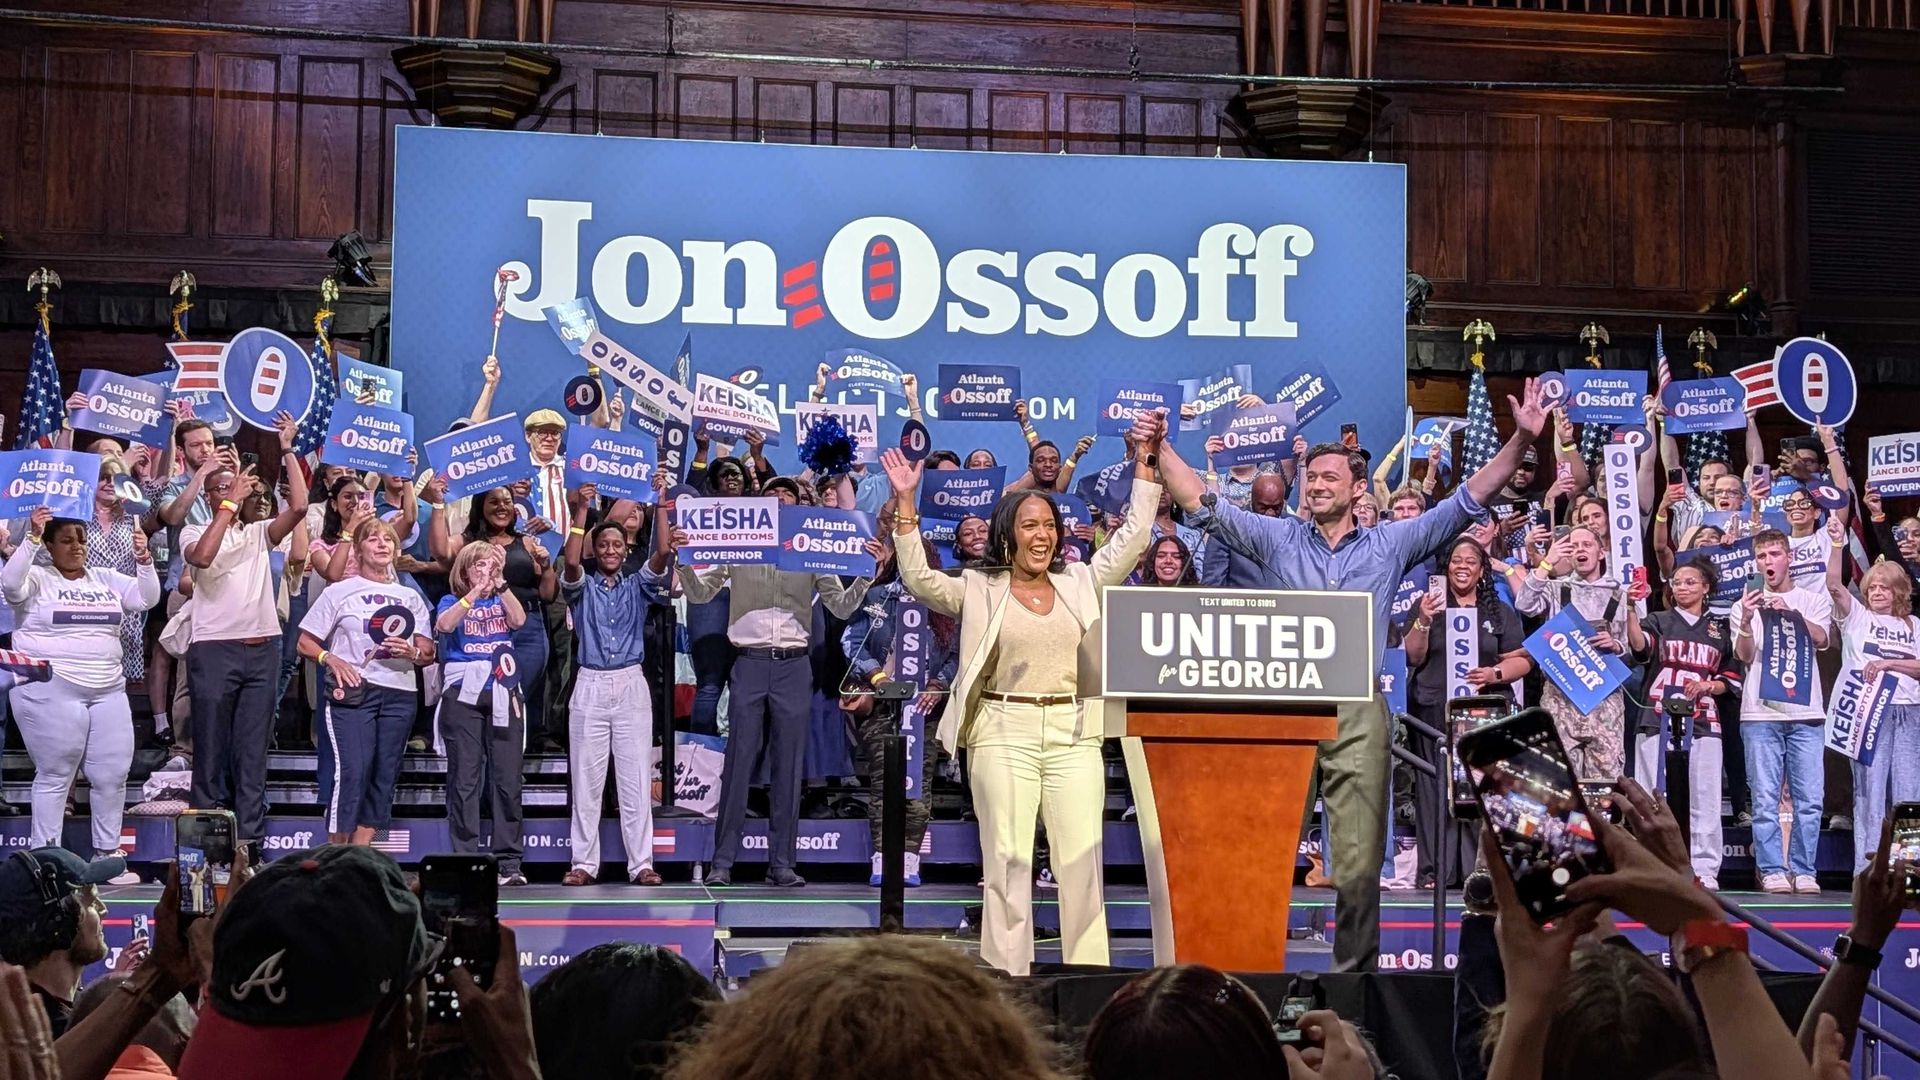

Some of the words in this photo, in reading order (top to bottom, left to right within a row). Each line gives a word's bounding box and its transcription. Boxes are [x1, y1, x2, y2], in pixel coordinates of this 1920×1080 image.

[495, 199, 788, 326] Jon
[822, 216, 1315, 338] Ossoff
[844, 355, 888, 370] Atlanta
[836, 365, 897, 384] Ossoff
[958, 374, 1005, 385] Atlanta
[1583, 379, 1629, 389] Atlanta
[101, 382, 157, 405] Atlanta
[1116, 389, 1164, 403] Atlanta
[1198, 376, 1234, 396] Atlanta
[1276, 373, 1312, 403] Atlanta
[1681, 386, 1727, 399] Atlanta
[950, 388, 1013, 405] Ossoff
[1192, 385, 1242, 415] Ossoff
[1576, 391, 1637, 408] Ossoff
[88, 394, 163, 428] Ossoff
[1674, 397, 1735, 418] Ossoff
[353, 414, 401, 434] Atlanta
[1230, 414, 1278, 429] Atlanta
[341, 428, 408, 456] Ossoff
[451, 433, 504, 458] Atlanta
[1223, 425, 1287, 449] Ossoff
[591, 439, 645, 459] Atlanta
[19, 459, 75, 475] Atlanta
[447, 444, 517, 480] Ossoff
[579, 453, 651, 482] Ossoff
[1871, 468, 1900, 477] LANCE
[9, 478, 84, 498] Ossoff
[944, 478, 989, 488] Atlanta
[934, 489, 995, 507] Ossoff
[682, 507, 774, 530] KEISHA
[802, 517, 857, 532] Atlanta
[722, 533, 774, 541] BOTTOMS
[933, 525, 954, 534] Jon
[792, 533, 866, 555] Ossoff
[693, 550, 763, 561] GOVERNOR
[58, 588, 118, 602] KEISHA
[1200, 598, 1220, 606] TEXT
[1246, 599, 1256, 607] TO
[1141, 612, 1336, 660] UNITED
[1569, 629, 1608, 672] Atlanta
[1770, 625, 1780, 679] Atlanta
[1781, 617, 1797, 689] Ossoff
[1549, 633, 1605, 691] Ossoff
[1158, 663, 1177, 685] for
[1178, 660, 1323, 689] GEORGIA
[1831, 669, 1866, 750] KEISHA
[1865, 688, 1891, 750] GOVERNOR
[1850, 721, 1862, 754] LANCE
